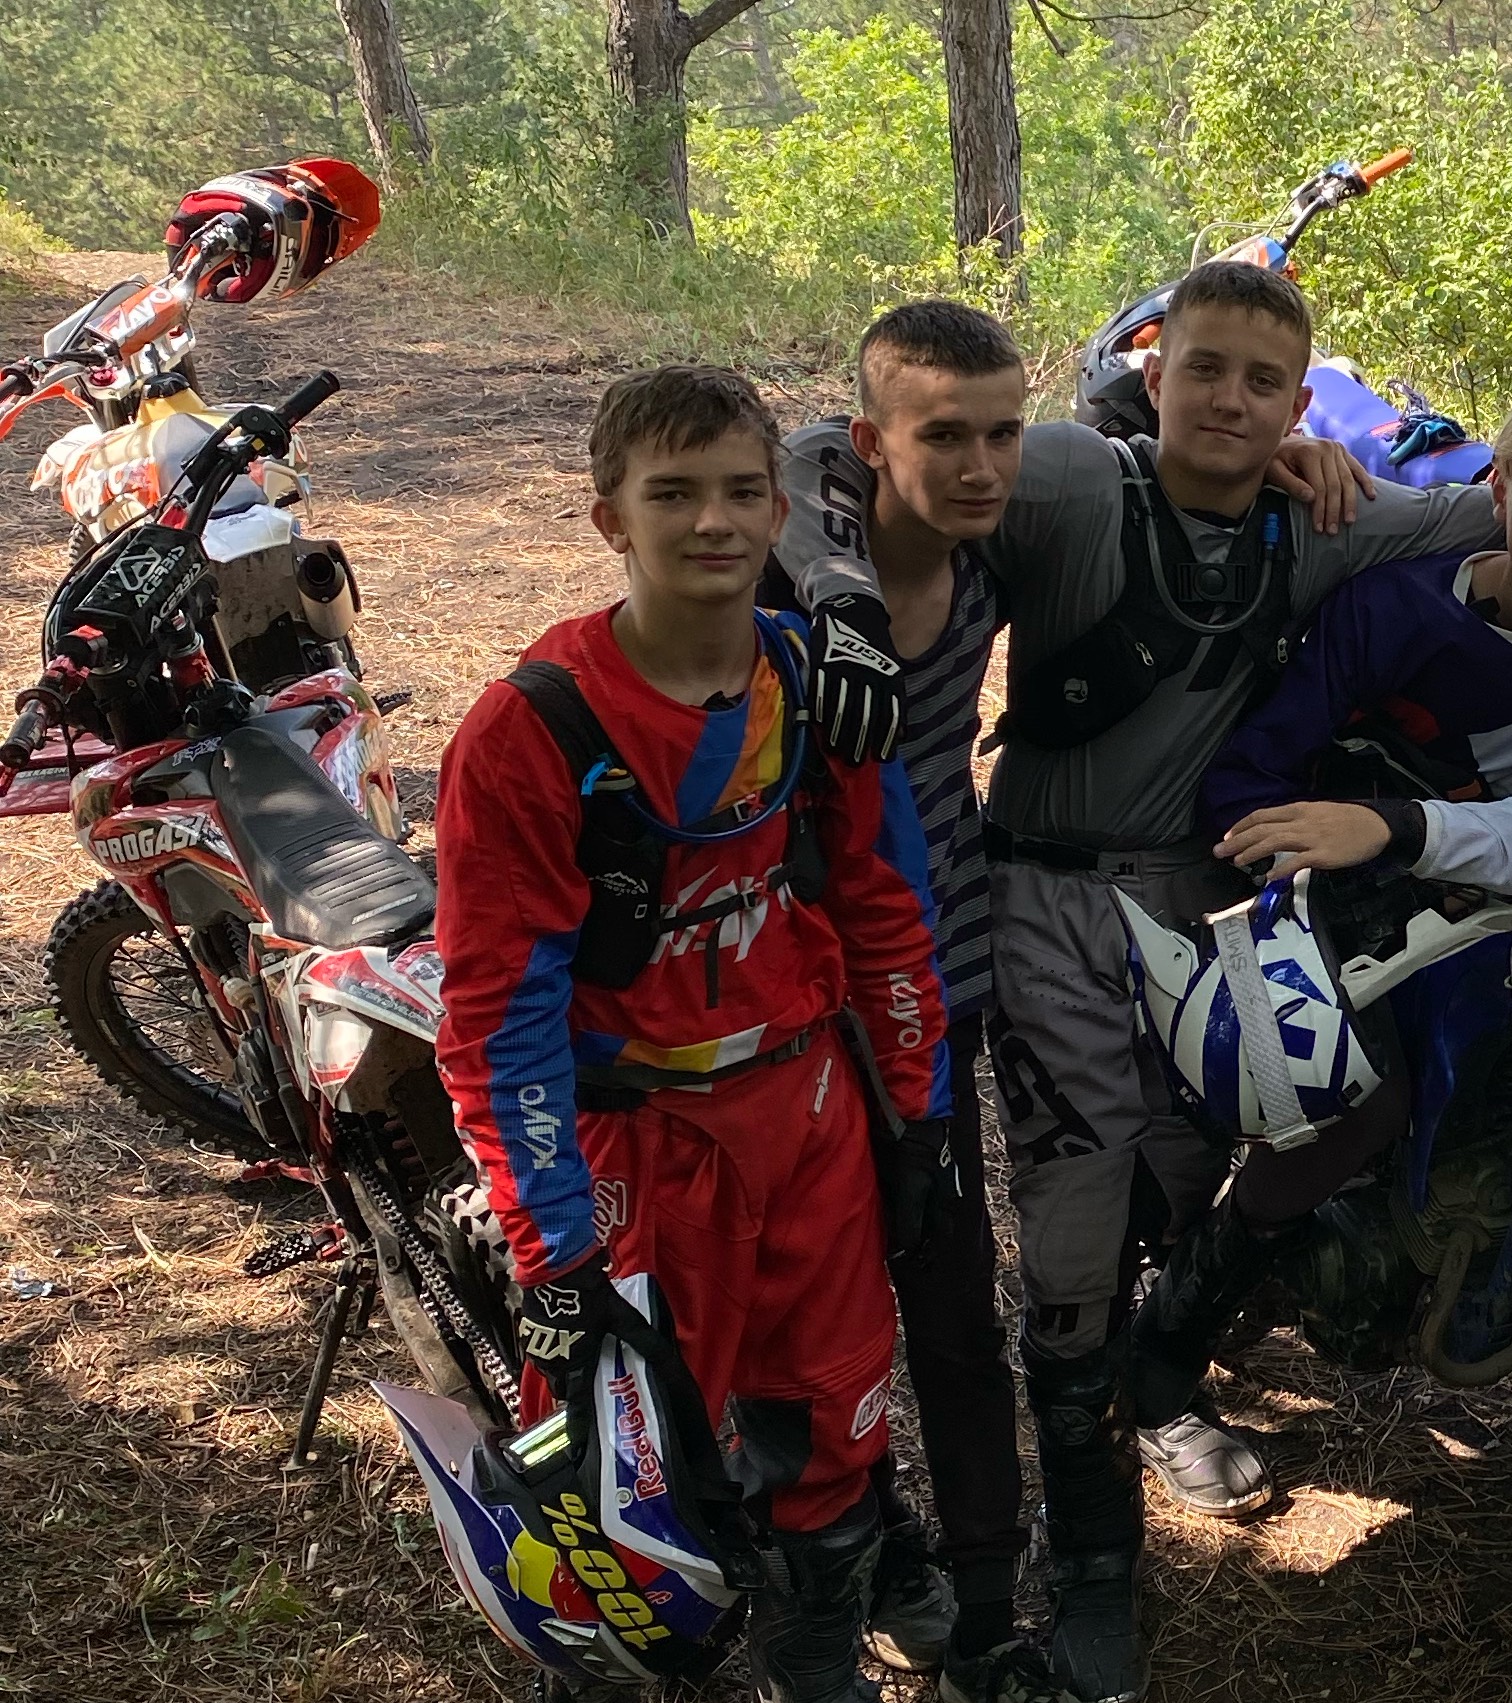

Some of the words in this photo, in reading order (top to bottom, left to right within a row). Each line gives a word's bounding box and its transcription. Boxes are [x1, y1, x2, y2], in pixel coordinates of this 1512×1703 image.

[135, 545, 185, 608] ACERBIS
[150, 562, 202, 633] ACERBIS
[1223, 917, 1249, 974] SMITH
[887, 973, 923, 1049] KAYO
[517, 1083, 562, 1171] KAYO
[519, 1315, 585, 1361] FOX
[540, 1491, 672, 1652] 100%
